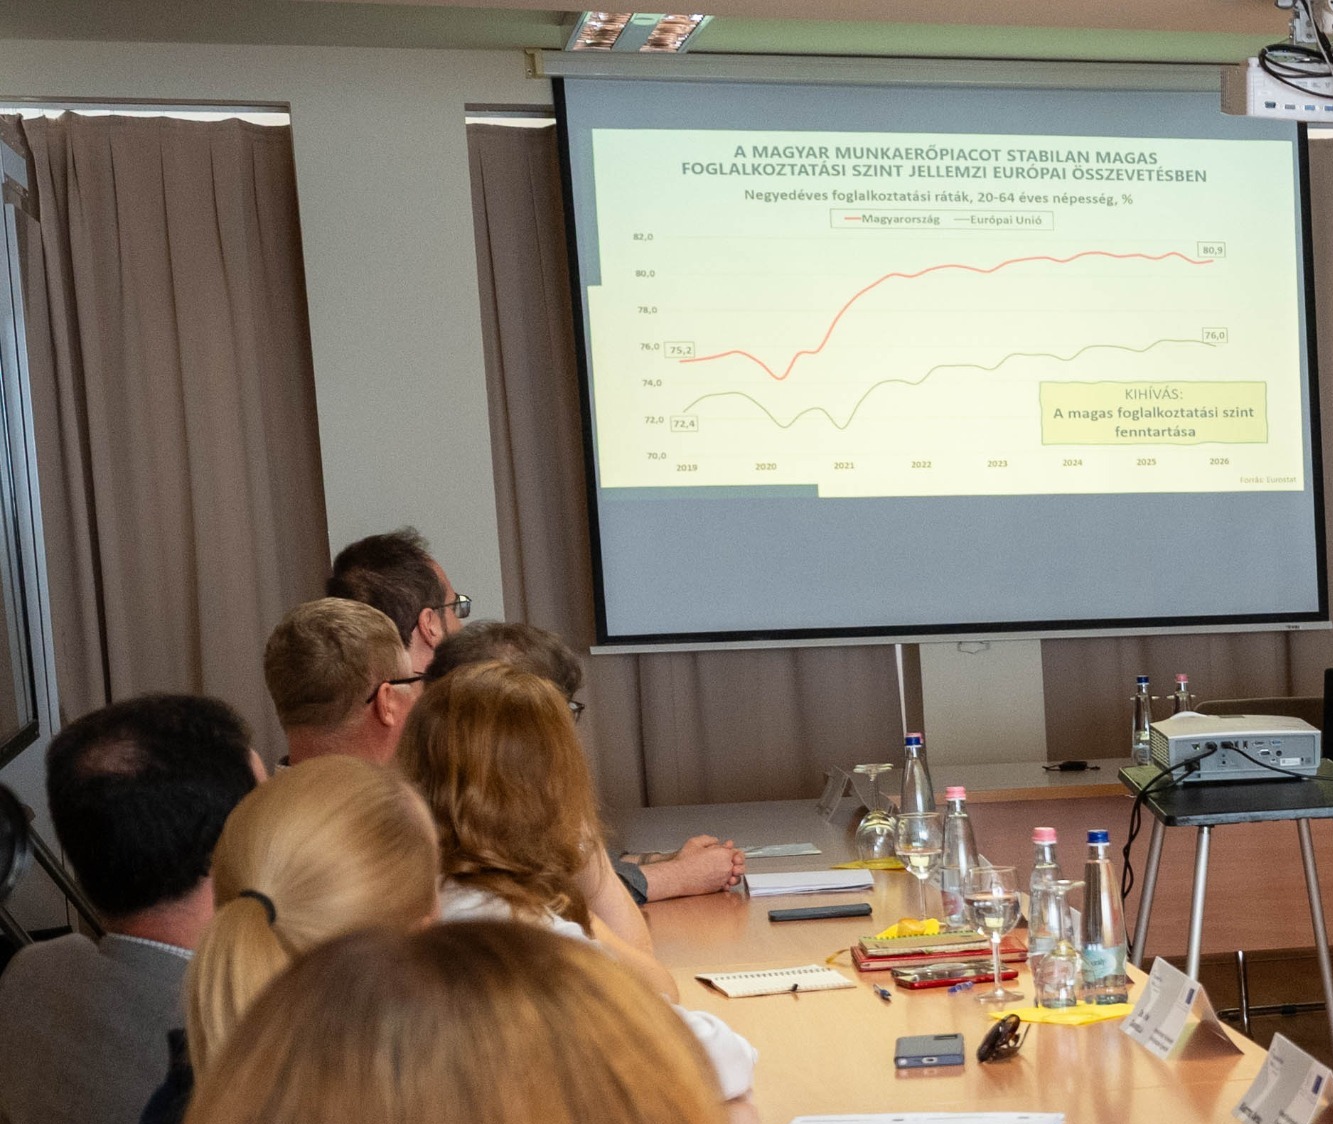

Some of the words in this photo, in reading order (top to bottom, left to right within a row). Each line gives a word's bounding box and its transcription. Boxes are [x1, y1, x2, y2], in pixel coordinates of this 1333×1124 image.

[734, 146, 747, 159] A
[752, 146, 830, 160] MAGYAR
[835, 145, 1001, 162] MUNKAERŐPIACOT
[1006, 150, 1090, 164] STABILAN
[1095, 152, 1158, 165] MAGAS
[681, 160, 846, 177] FOGLALKOZTATÁSI
[852, 165, 903, 177] SZINT
[909, 165, 986, 178] JELLEMZI
[993, 164, 1066, 179] EURÓPAI
[1072, 165, 1206, 182] ÖSSZEVETÉSBEN
[745, 189, 828, 202] Negyedéves
[832, 190, 930, 203] foglalkoztatási
[935, 191, 972, 204] ráták,
[978, 192, 1014, 202] 20-64
[1019, 192, 1048, 203] éves
[1053, 193, 1117, 206] népesség,
[1122, 194, 1133, 204] %
[861, 214, 940, 226] Magyarország
[970, 214, 1013, 226] Európai
[1016, 216, 1042, 225] Unió
[633, 233, 653, 241] 82,0
[1202, 245, 1222, 256] 80,9
[638, 306, 657, 314] 78,0
[1204, 330, 1225, 341] 76,0
[641, 343, 660, 351] 76,0
[670, 345, 693, 356] 75,2
[642, 379, 662, 387] 74,0
[1126, 386, 1183, 399] KIHÍVÁS:
[1054, 408, 1063, 418] A
[1069, 410, 1113, 421] magas
[1118, 407, 1218, 421] foglalkoztatási
[1223, 407, 1254, 417] szint
[645, 416, 664, 424] 72,0
[673, 418, 696, 430] 72,4
[1115, 426, 1195, 437] fenntartása
[647, 452, 666, 460] 70,0
[1137, 458, 1156, 466] 2025
